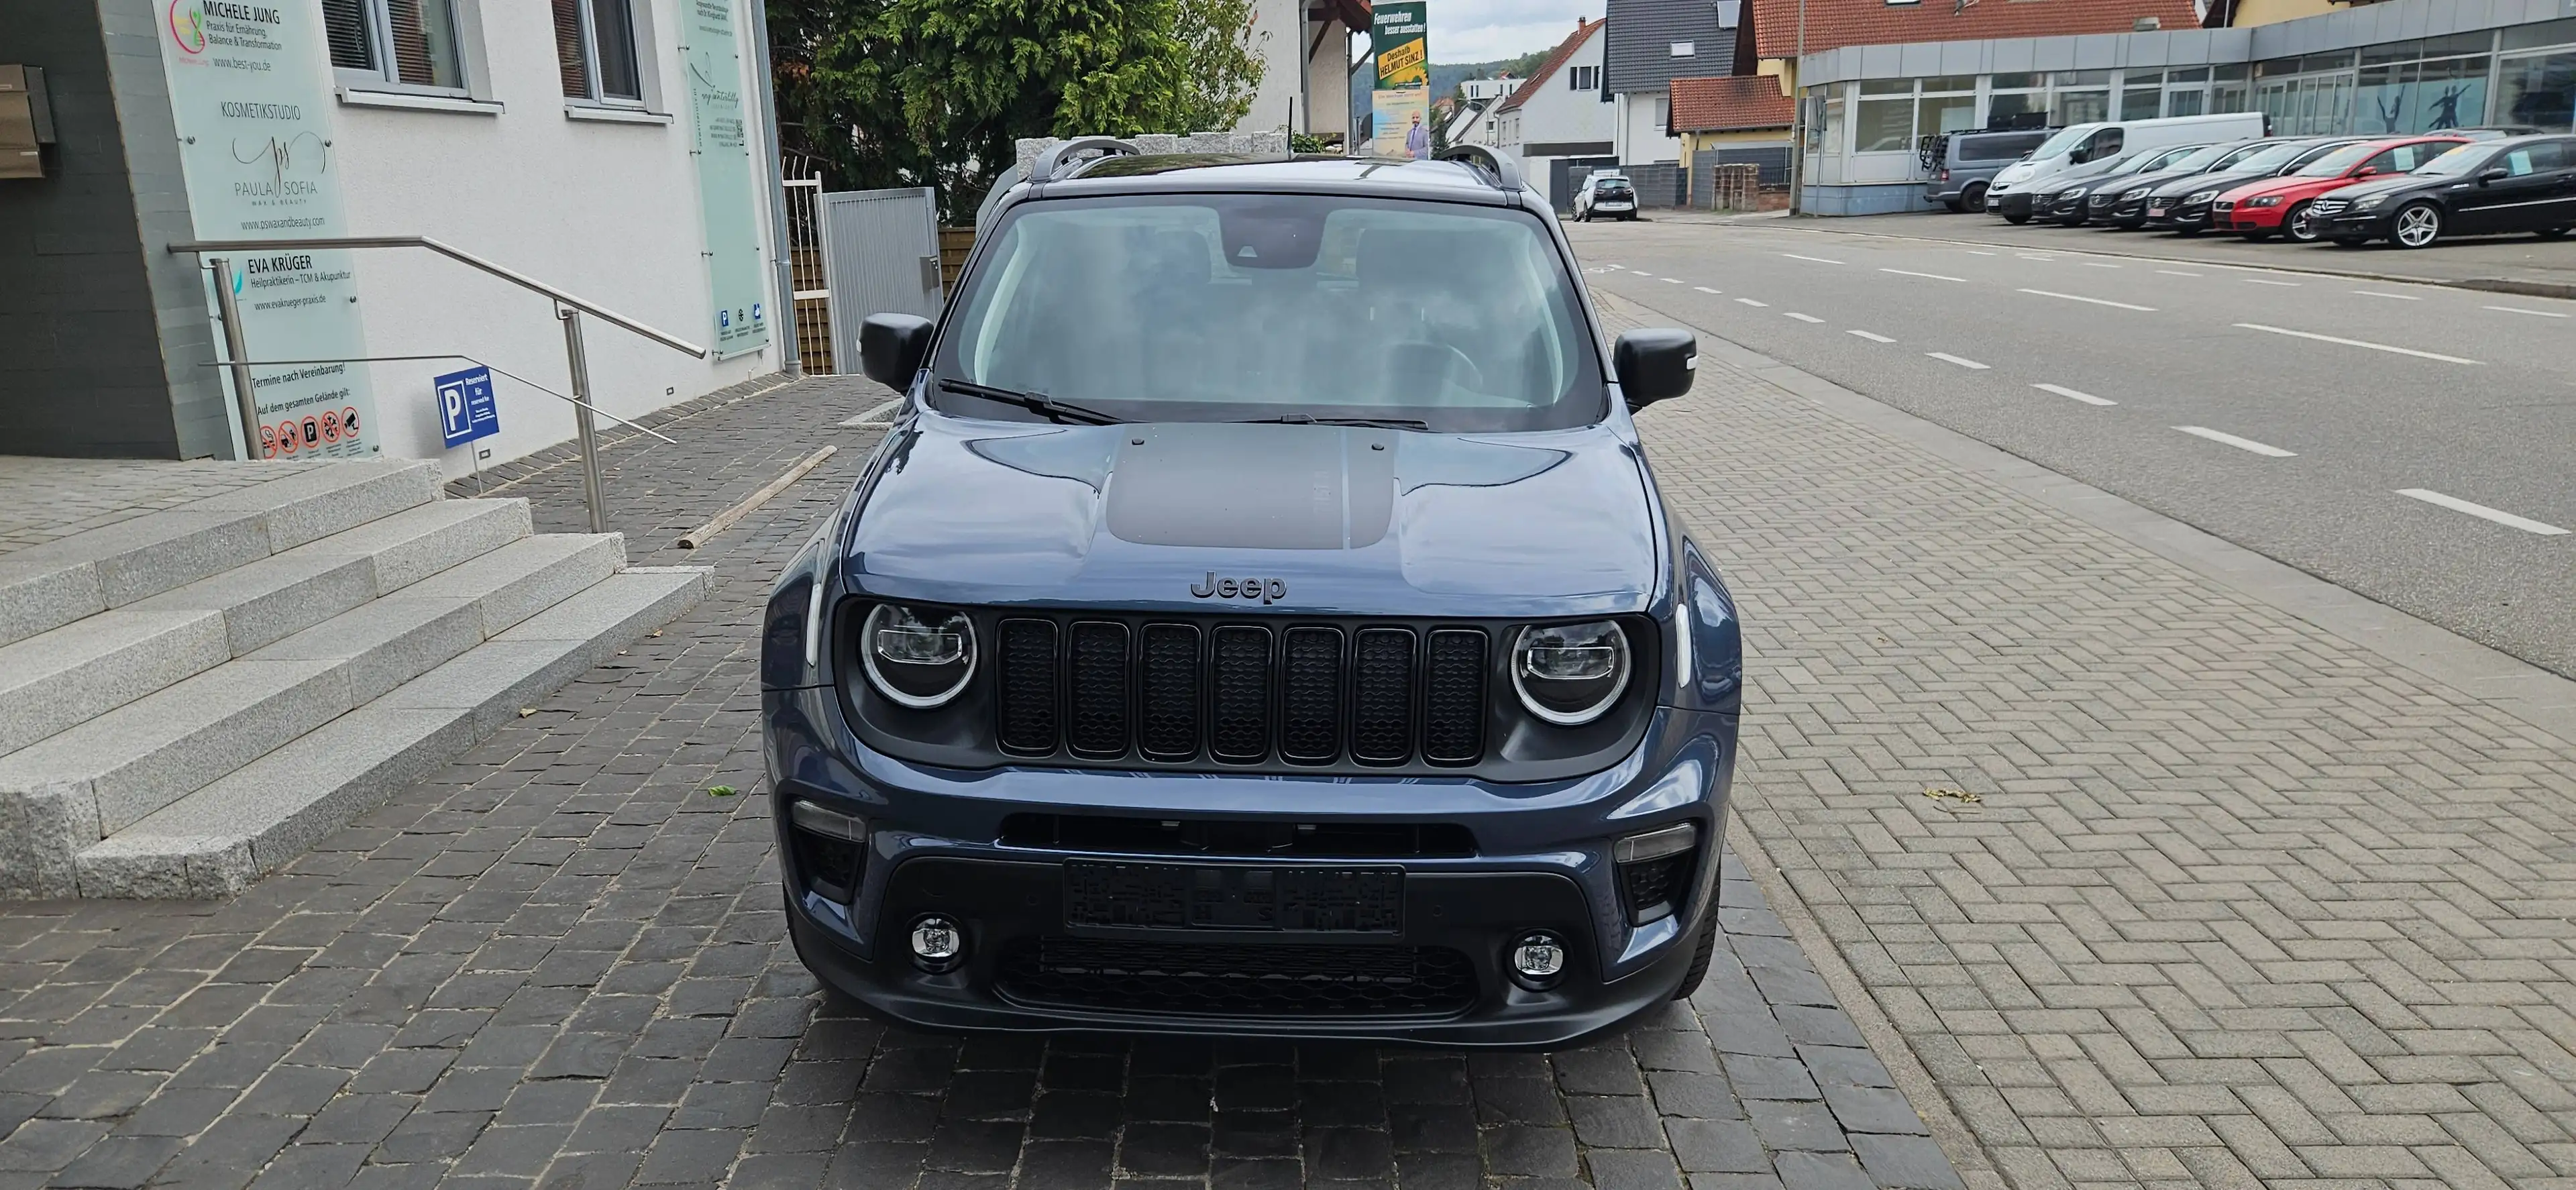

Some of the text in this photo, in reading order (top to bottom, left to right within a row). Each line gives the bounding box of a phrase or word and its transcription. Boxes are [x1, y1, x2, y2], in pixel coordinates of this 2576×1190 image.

[203, 1, 280, 24] MICHELE JUNG
[1374, 11, 1412, 25] Feuerwehren
[206, 21, 225, 32] Praxis
[225, 23, 235, 32] für
[1385, 25, 1400, 36] besser
[209, 34, 282, 50] Balance & Transformation
[1387, 46, 1411, 62] Deshalb
[213, 57, 271, 72] www.best-you.de
[1380, 58, 1405, 77] HELMUT
[1405, 51, 1419, 65] SINZ
[221, 101, 301, 120] KOSMETIKSTUDIO
[234, 181, 319, 197] PAULA SOFIA
[241, 216, 325, 230] www.pswaxandbeauty.com
[248, 253, 313, 274] EVA KRÜGER
[251, 275, 294, 290] Heilpraktikerin
[300, 273, 313, 284] TCM
[315, 272, 319, 282] &
[320, 270, 351, 283] Akupunktur
[254, 294, 327, 311] www.evakrueger-praxis.de
[252, 362, 345, 389] Termine nach Vereinbarung!
[465, 374, 488, 386] Reserviert
[258, 404, 268, 416] Auf
[270, 402, 284, 413] dem
[285, 396, 314, 412] gesamten
[315, 390, 338, 402] Gelände
[1191, 571, 1287, 605] Jeep
